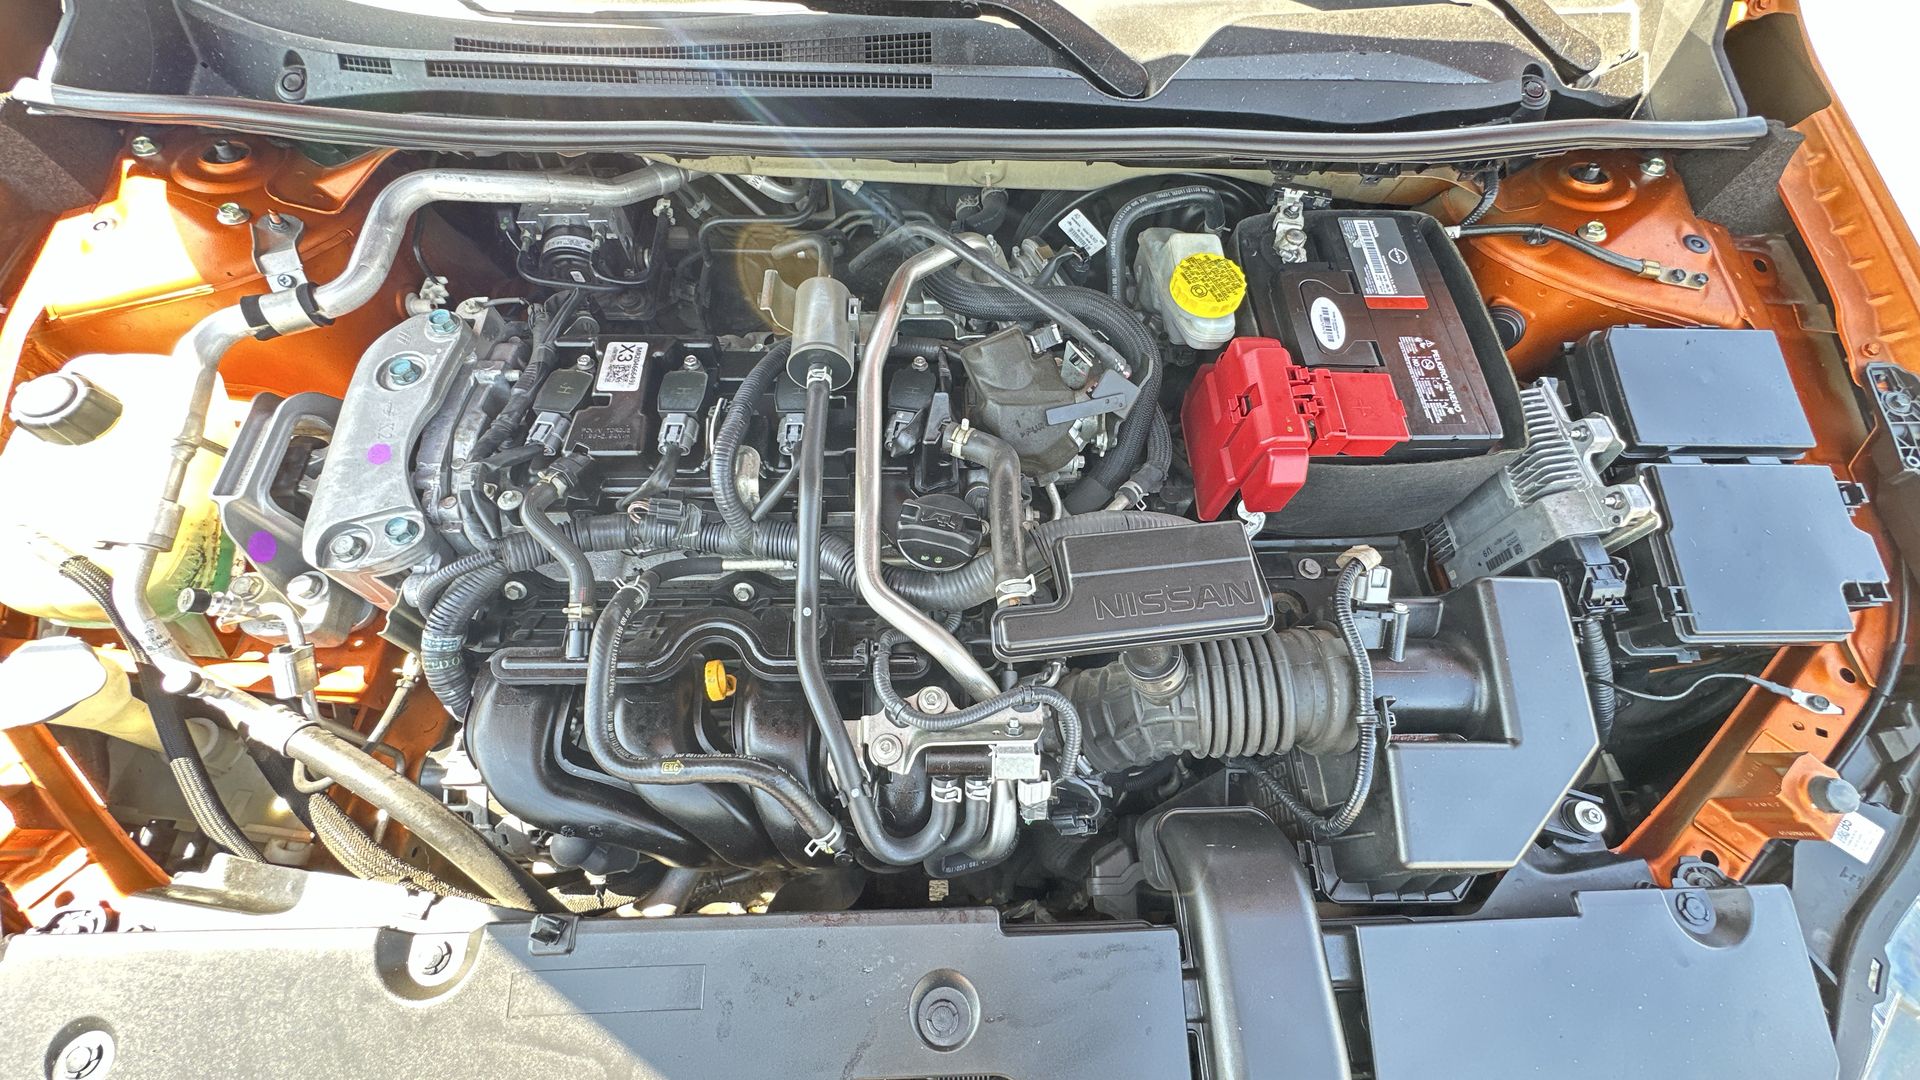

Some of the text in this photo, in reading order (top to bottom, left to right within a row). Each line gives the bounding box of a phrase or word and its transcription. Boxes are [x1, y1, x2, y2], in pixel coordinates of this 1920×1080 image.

[617, 344, 636, 362] X3
[1431, 349, 1462, 413] PELIGRO/VENENO
[1093, 580, 1256, 621] NISSAN
